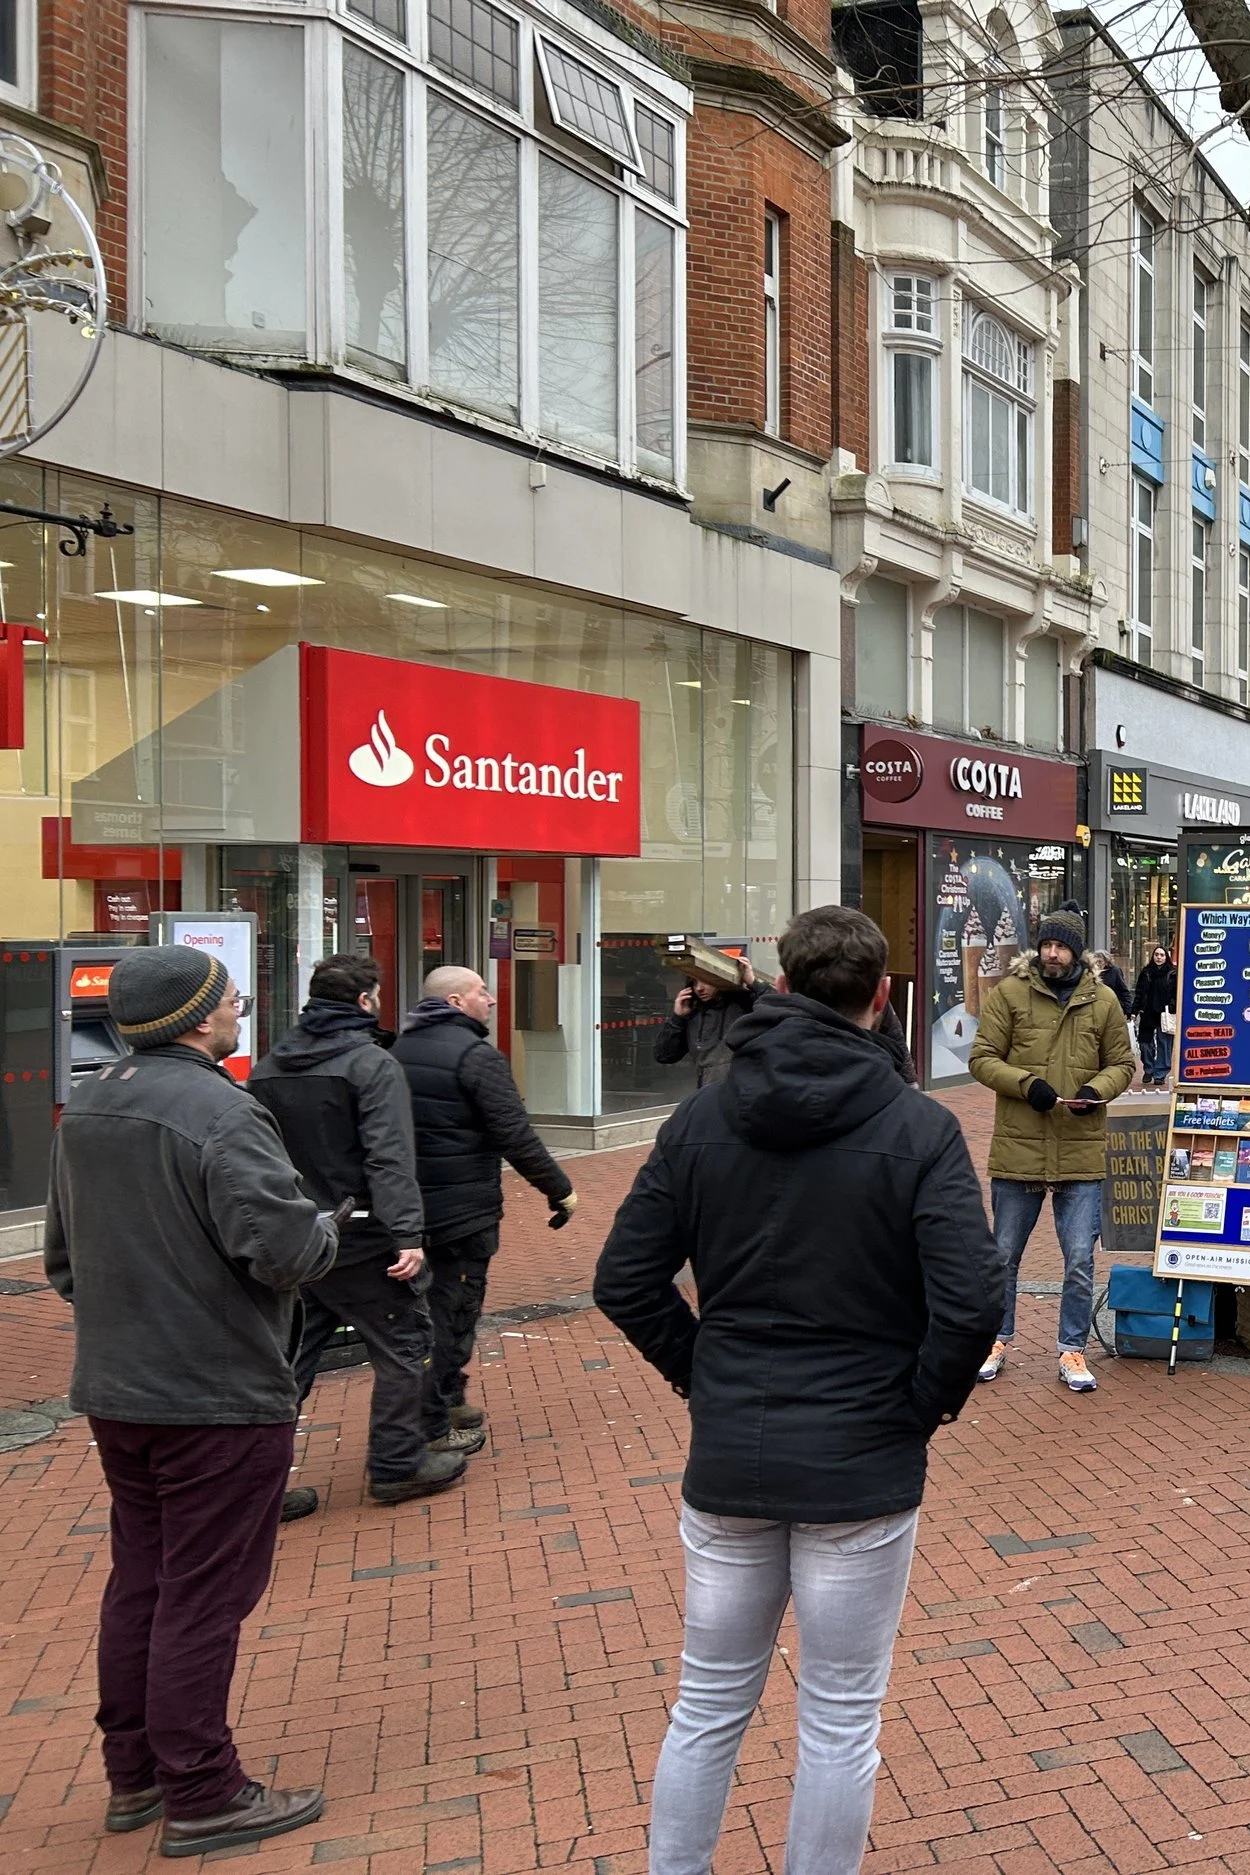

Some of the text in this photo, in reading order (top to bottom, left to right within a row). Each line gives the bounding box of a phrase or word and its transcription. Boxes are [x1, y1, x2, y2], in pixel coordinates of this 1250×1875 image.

[424, 733, 624, 803] Santander
[865, 761, 913, 775] COSTA
[953, 757, 1023, 800] COSTA
[966, 803, 1004, 821] COFFEE
[1183, 792, 1241, 827] LAKELAND
[941, 884, 968, 894] Christmas
[1201, 913, 1227, 925] Which
[183, 934, 224, 946] Opening
[1202, 931, 1225, 940] Money?
[1187, 1047, 1228, 1058] ALL SINNERS
[1183, 1114, 1235, 1127] Free leaflets
[1104, 1132, 1127, 1152] FOR
[1128, 1131, 1152, 1151] THE
[1110, 1156, 1153, 1177] DEATH,
[1114, 1180, 1138, 1200] GOD
[1141, 1180, 1153, 1200] IS
[1112, 1205, 1155, 1225] CHRIST
[1185, 1253, 1223, 1263] OPEN-AIR
